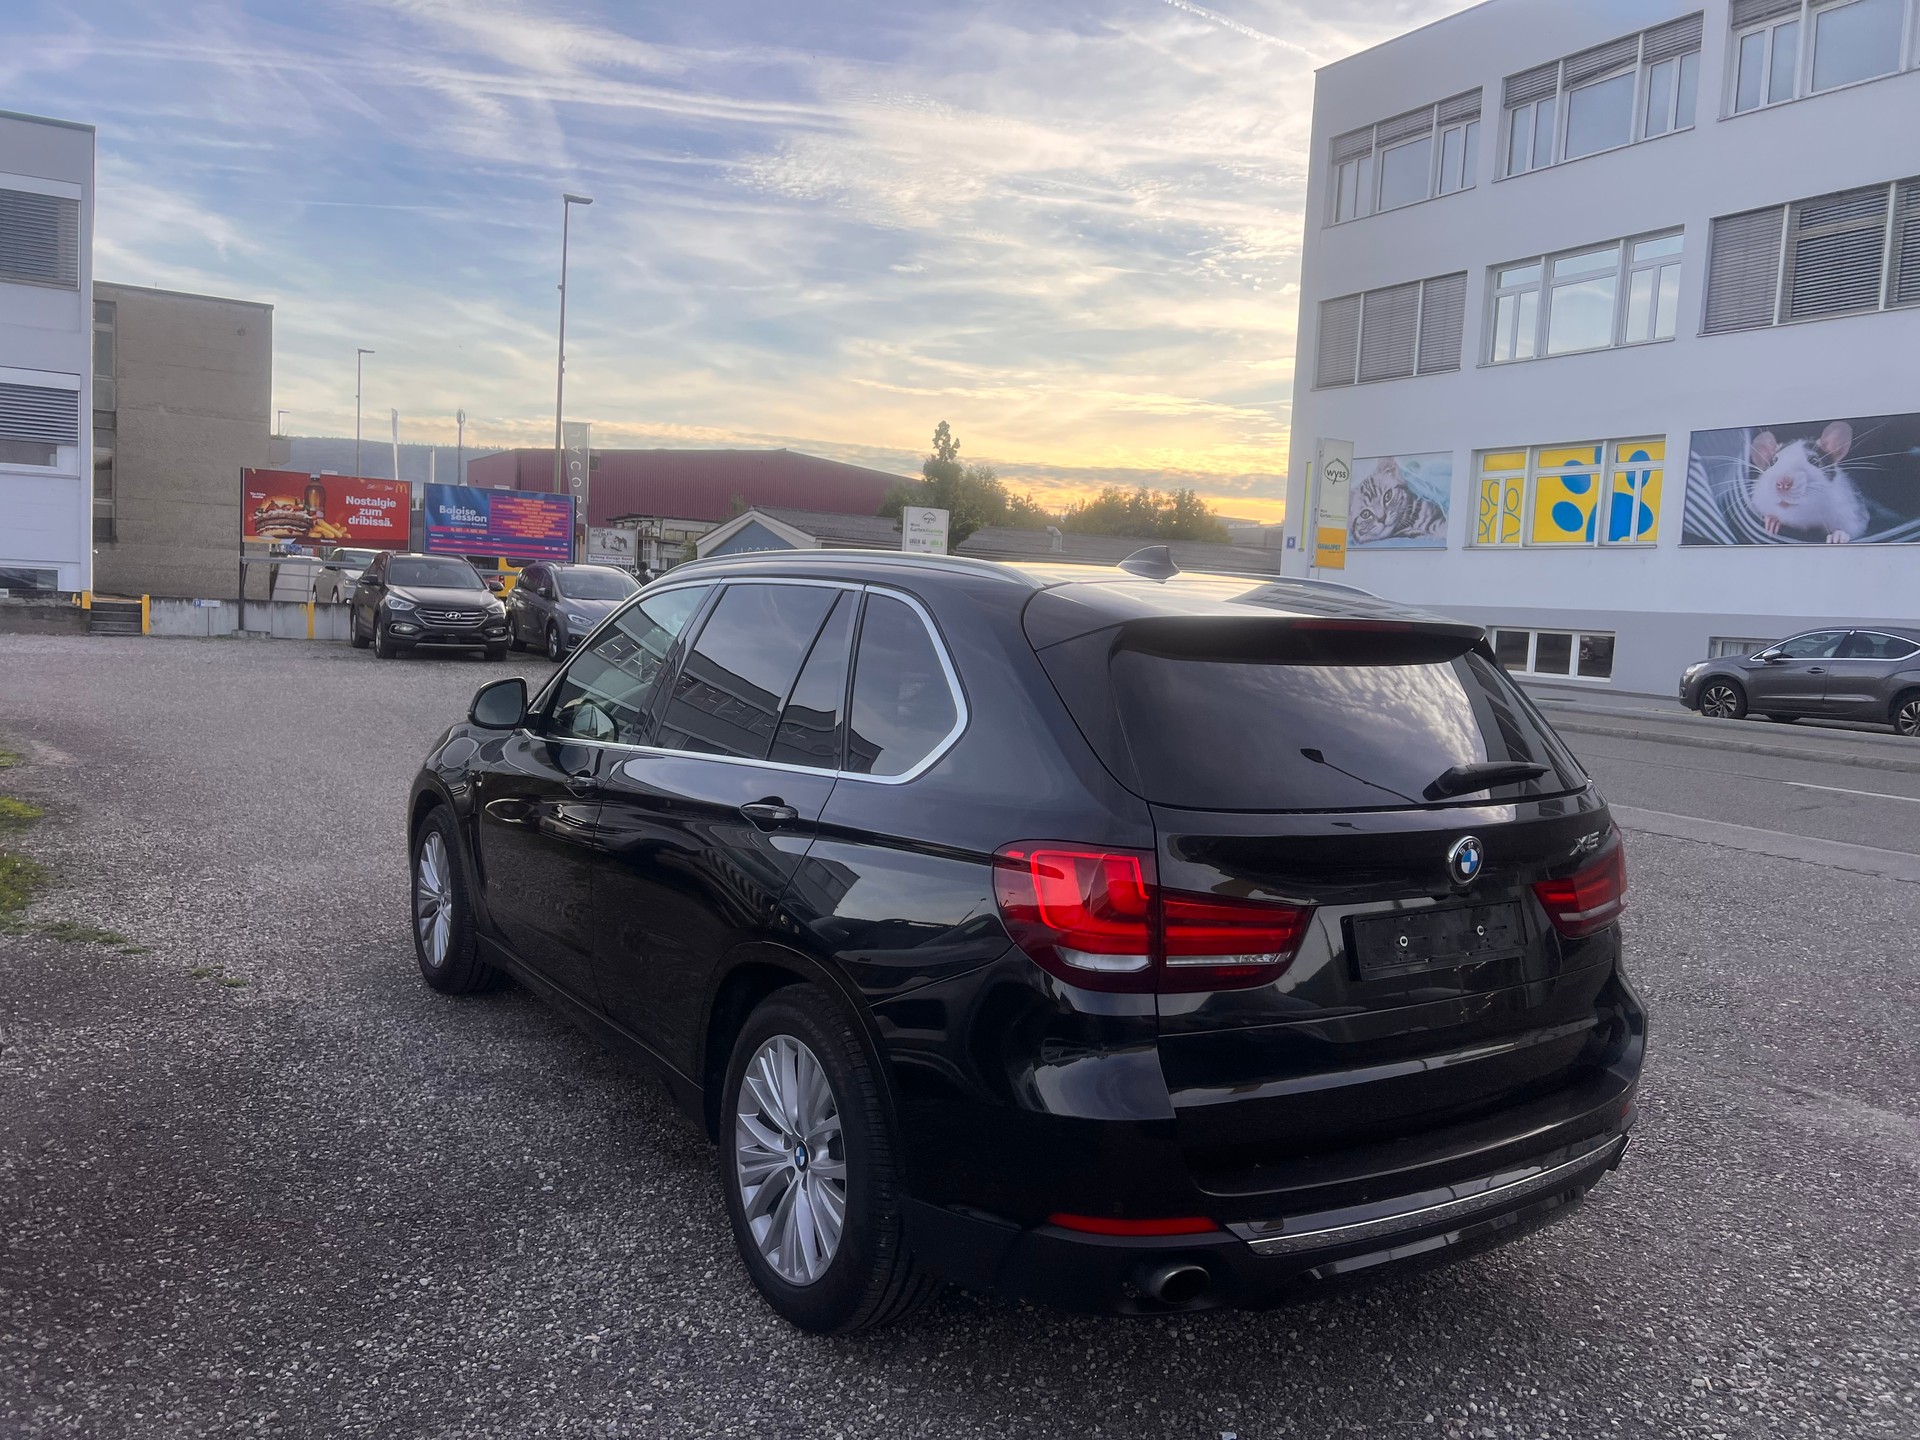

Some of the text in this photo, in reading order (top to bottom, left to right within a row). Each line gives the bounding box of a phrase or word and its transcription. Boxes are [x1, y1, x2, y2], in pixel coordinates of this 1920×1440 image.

[1327, 470, 1346, 485] wyss
[345, 495, 396, 508] Nostalgie
[359, 507, 382, 516] zum
[439, 504, 476, 515] Baloise
[348, 516, 393, 527] dribissä.
[450, 514, 487, 522] session
[1569, 831, 1600, 857] X5
